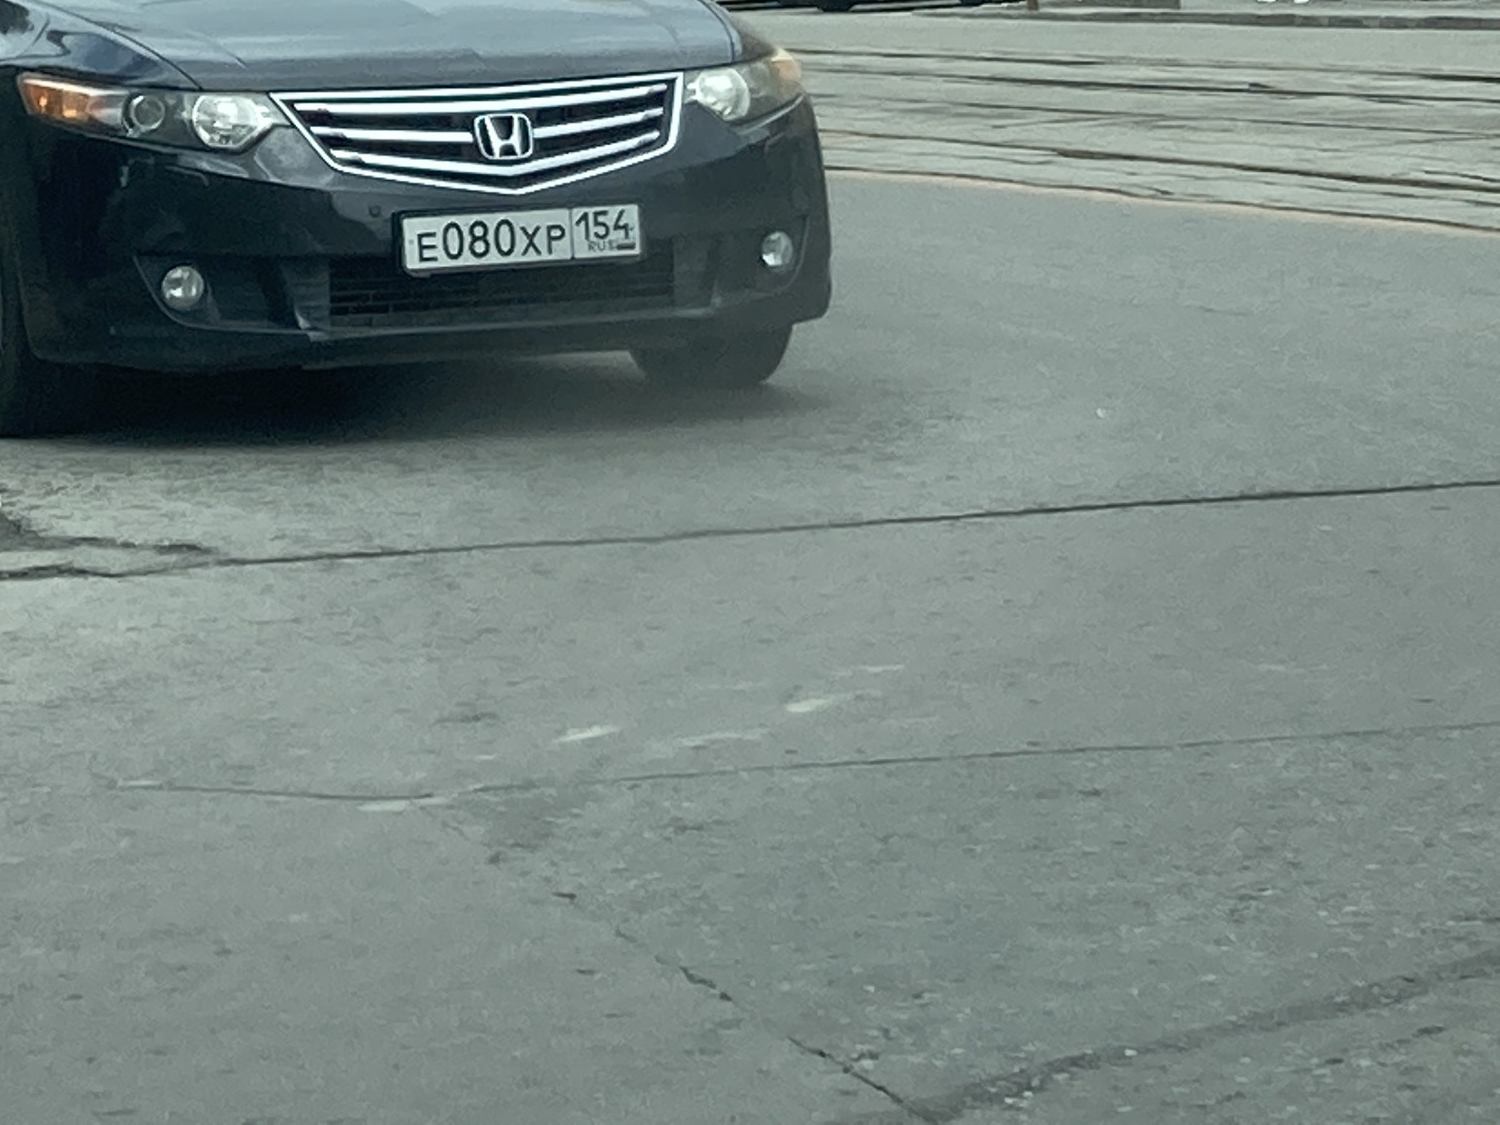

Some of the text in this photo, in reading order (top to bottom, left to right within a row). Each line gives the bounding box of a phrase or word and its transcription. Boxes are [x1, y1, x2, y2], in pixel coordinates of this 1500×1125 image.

[417, 209, 632, 262] Е080ХР 154
[587, 239, 616, 252] RUS
